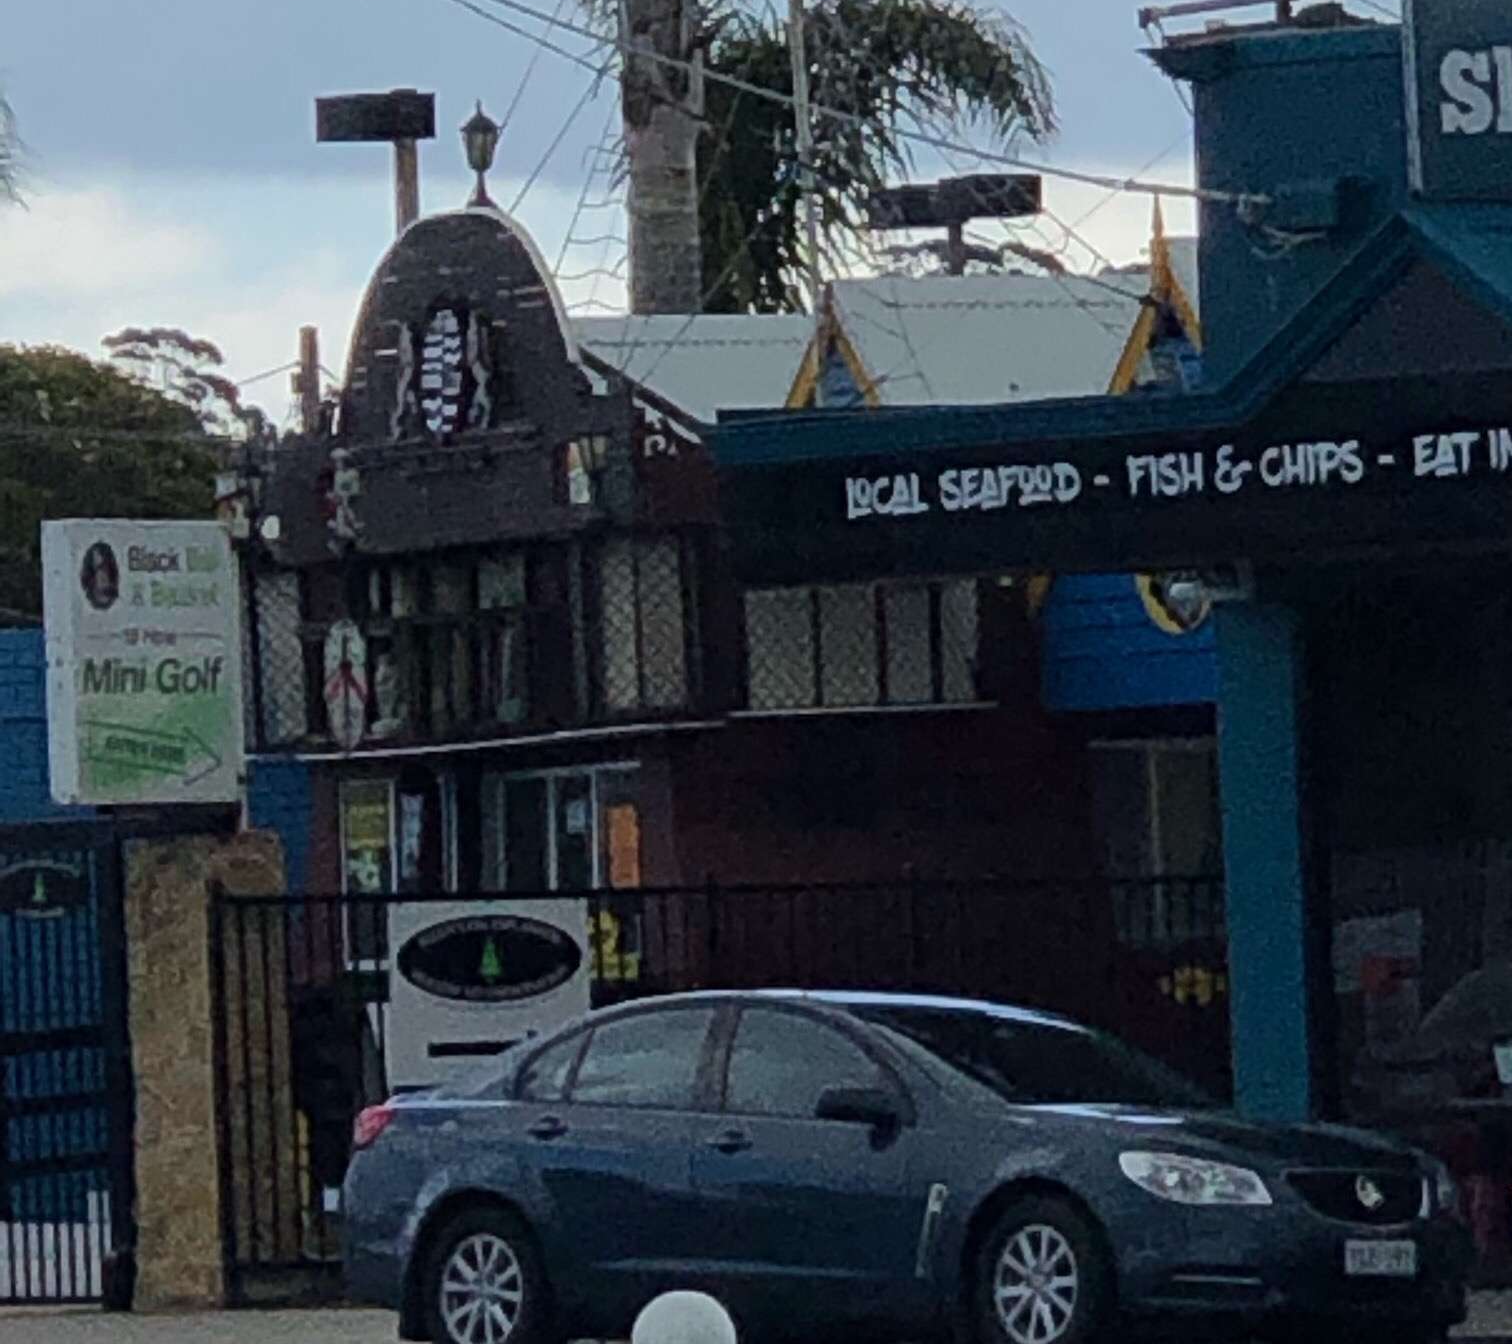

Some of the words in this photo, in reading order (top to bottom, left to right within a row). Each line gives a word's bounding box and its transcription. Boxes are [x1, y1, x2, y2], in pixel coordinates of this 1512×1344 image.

[845, 472, 929, 521] LOCAL
[938, 462, 1081, 513] SEAFOOD
[1126, 451, 1204, 497] FISH
[1214, 444, 1253, 494] &
[1258, 439, 1365, 487] CHIPS
[1413, 430, 1479, 477] EAT
[82, 657, 147, 695] Mini
[156, 655, 225, 695] Golf
